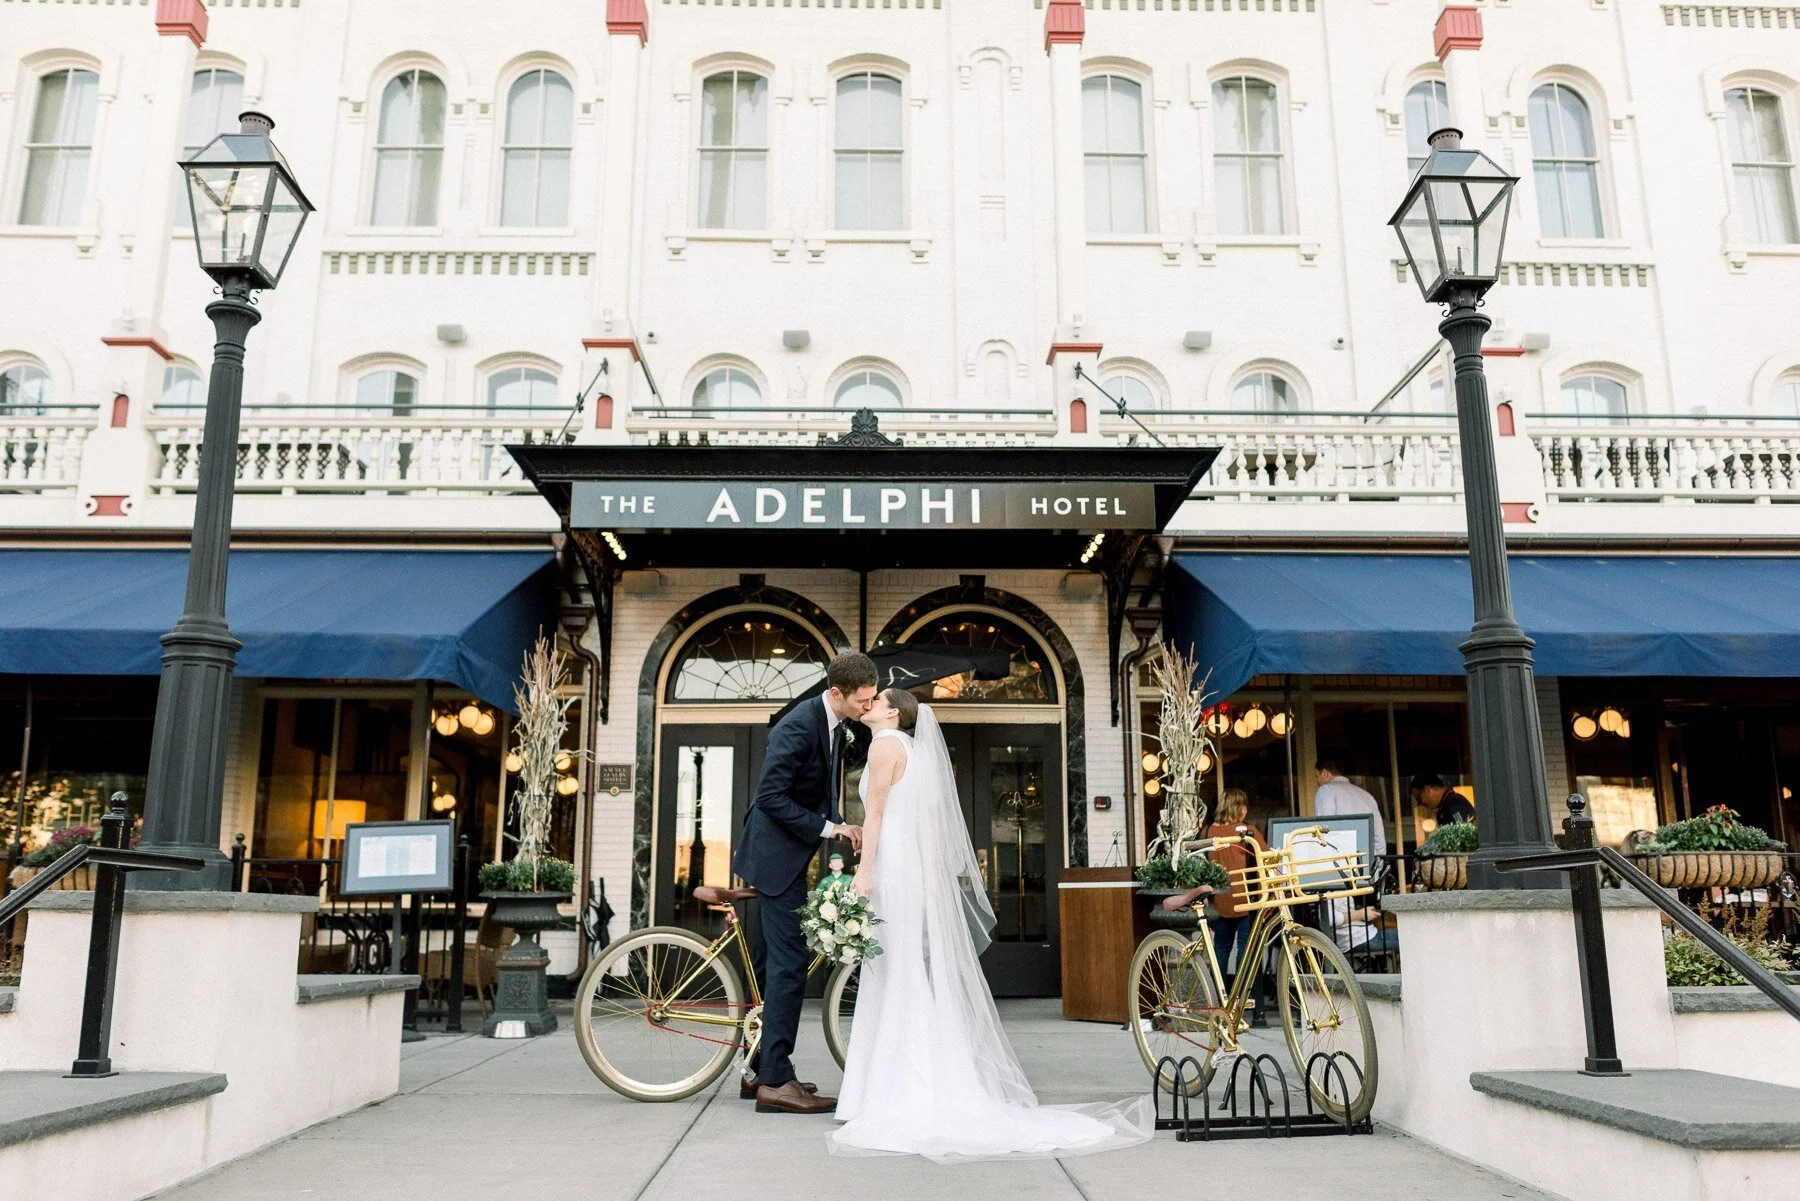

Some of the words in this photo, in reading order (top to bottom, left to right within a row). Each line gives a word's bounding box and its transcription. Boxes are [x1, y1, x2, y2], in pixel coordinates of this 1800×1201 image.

[600, 495, 656, 514] THE
[705, 487, 981, 524] ADELPHI
[1030, 497, 1127, 516] HOTEL
